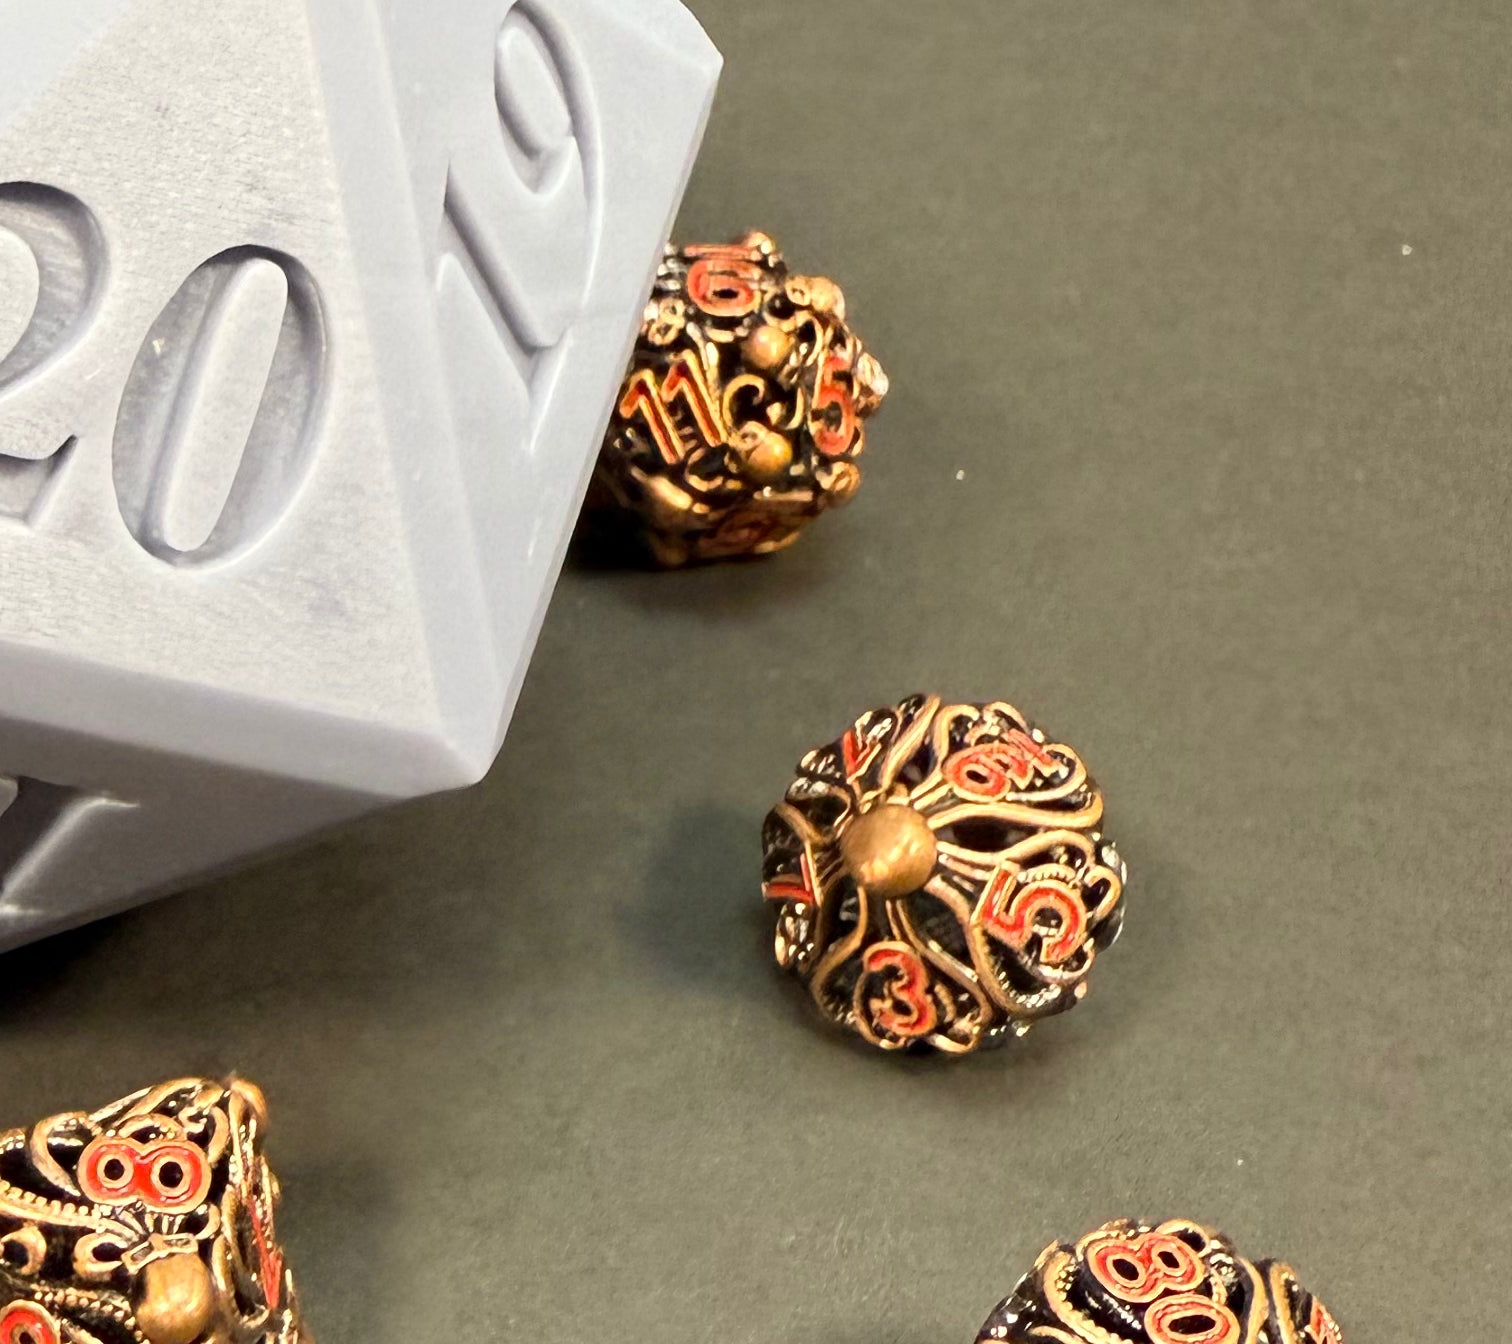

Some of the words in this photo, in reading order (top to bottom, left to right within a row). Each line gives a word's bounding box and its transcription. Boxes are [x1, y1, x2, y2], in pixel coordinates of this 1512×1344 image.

[972, 859, 1088, 964] 5
[862, 940, 937, 1037] 3
[78, 1136, 212, 1214] 8
